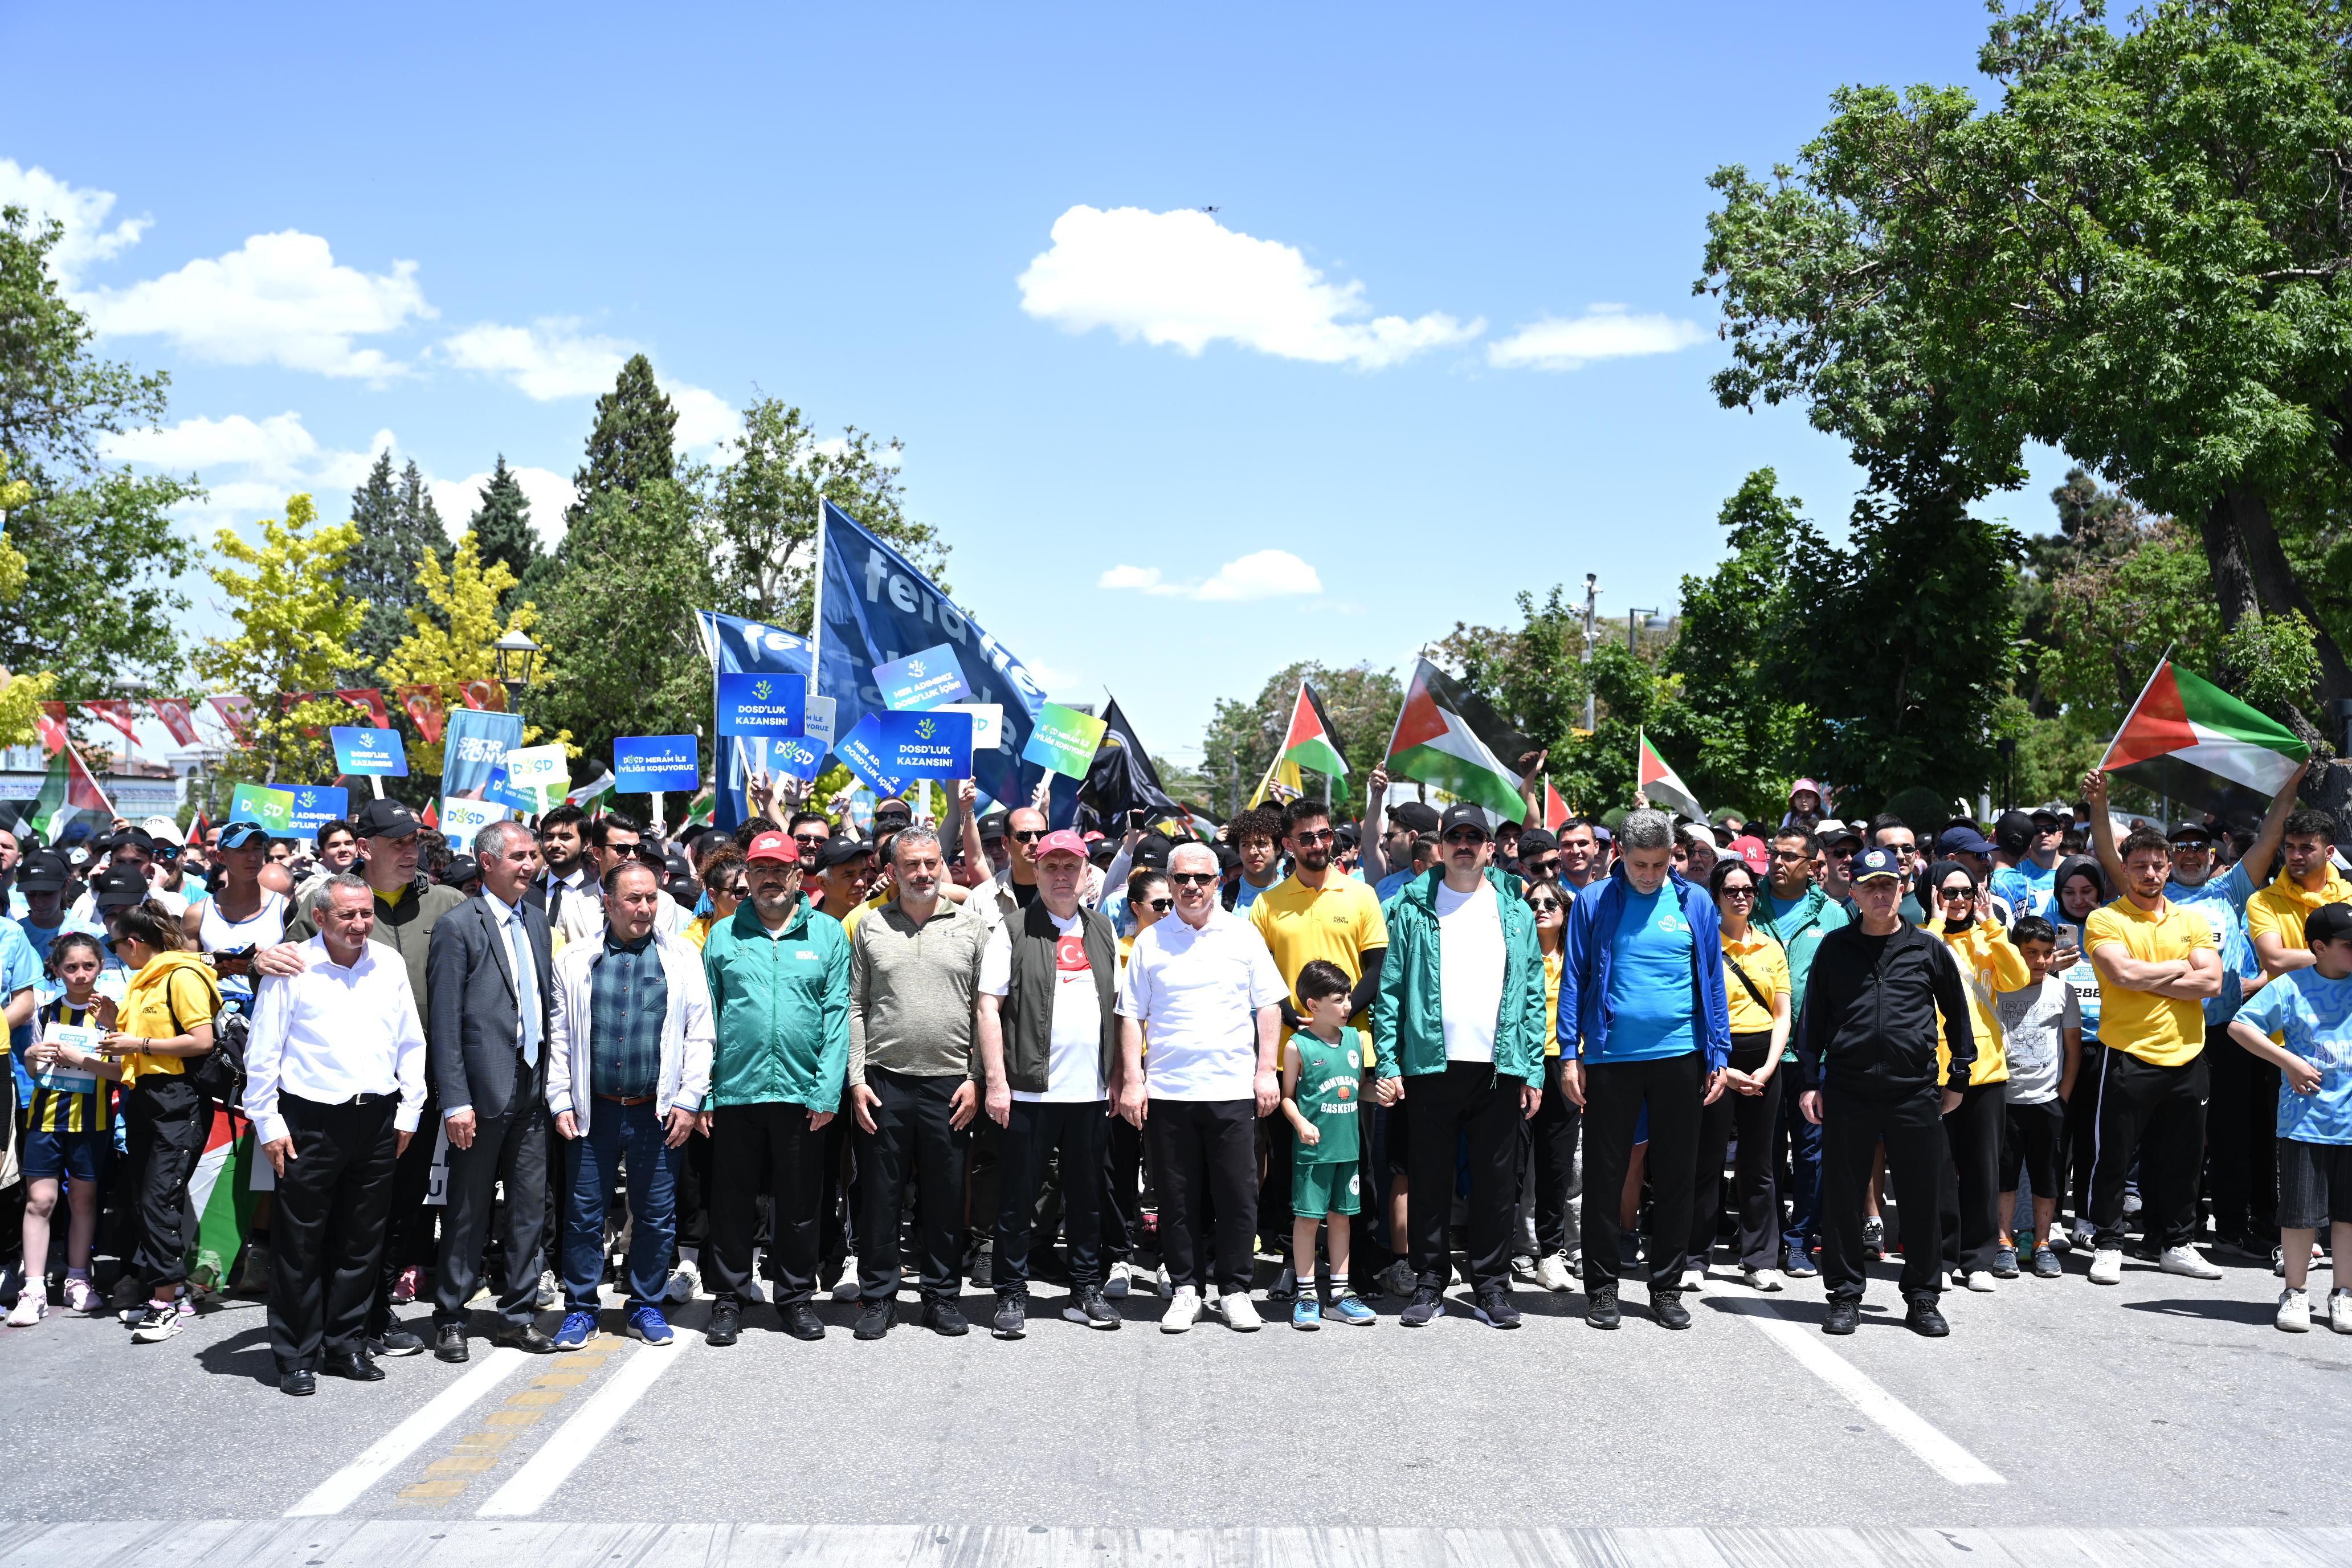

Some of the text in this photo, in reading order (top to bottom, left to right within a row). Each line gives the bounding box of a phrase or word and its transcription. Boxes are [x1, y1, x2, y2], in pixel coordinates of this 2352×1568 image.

[914, 672, 954, 692] ADIMINIZ
[738, 705, 786, 714] DOSD'LUK
[736, 717, 788, 725] KAZANSIN!
[813, 714, 823, 722] İLE
[1058, 732, 1080, 745] MERAM
[853, 740, 869, 756] HER
[900, 744, 951, 755] DOSD'LUK
[844, 744, 880, 779] DOSD'LUK
[897, 757, 953, 767] KAZANSIN!
[647, 764, 694, 773] KOŞUYORUZ
